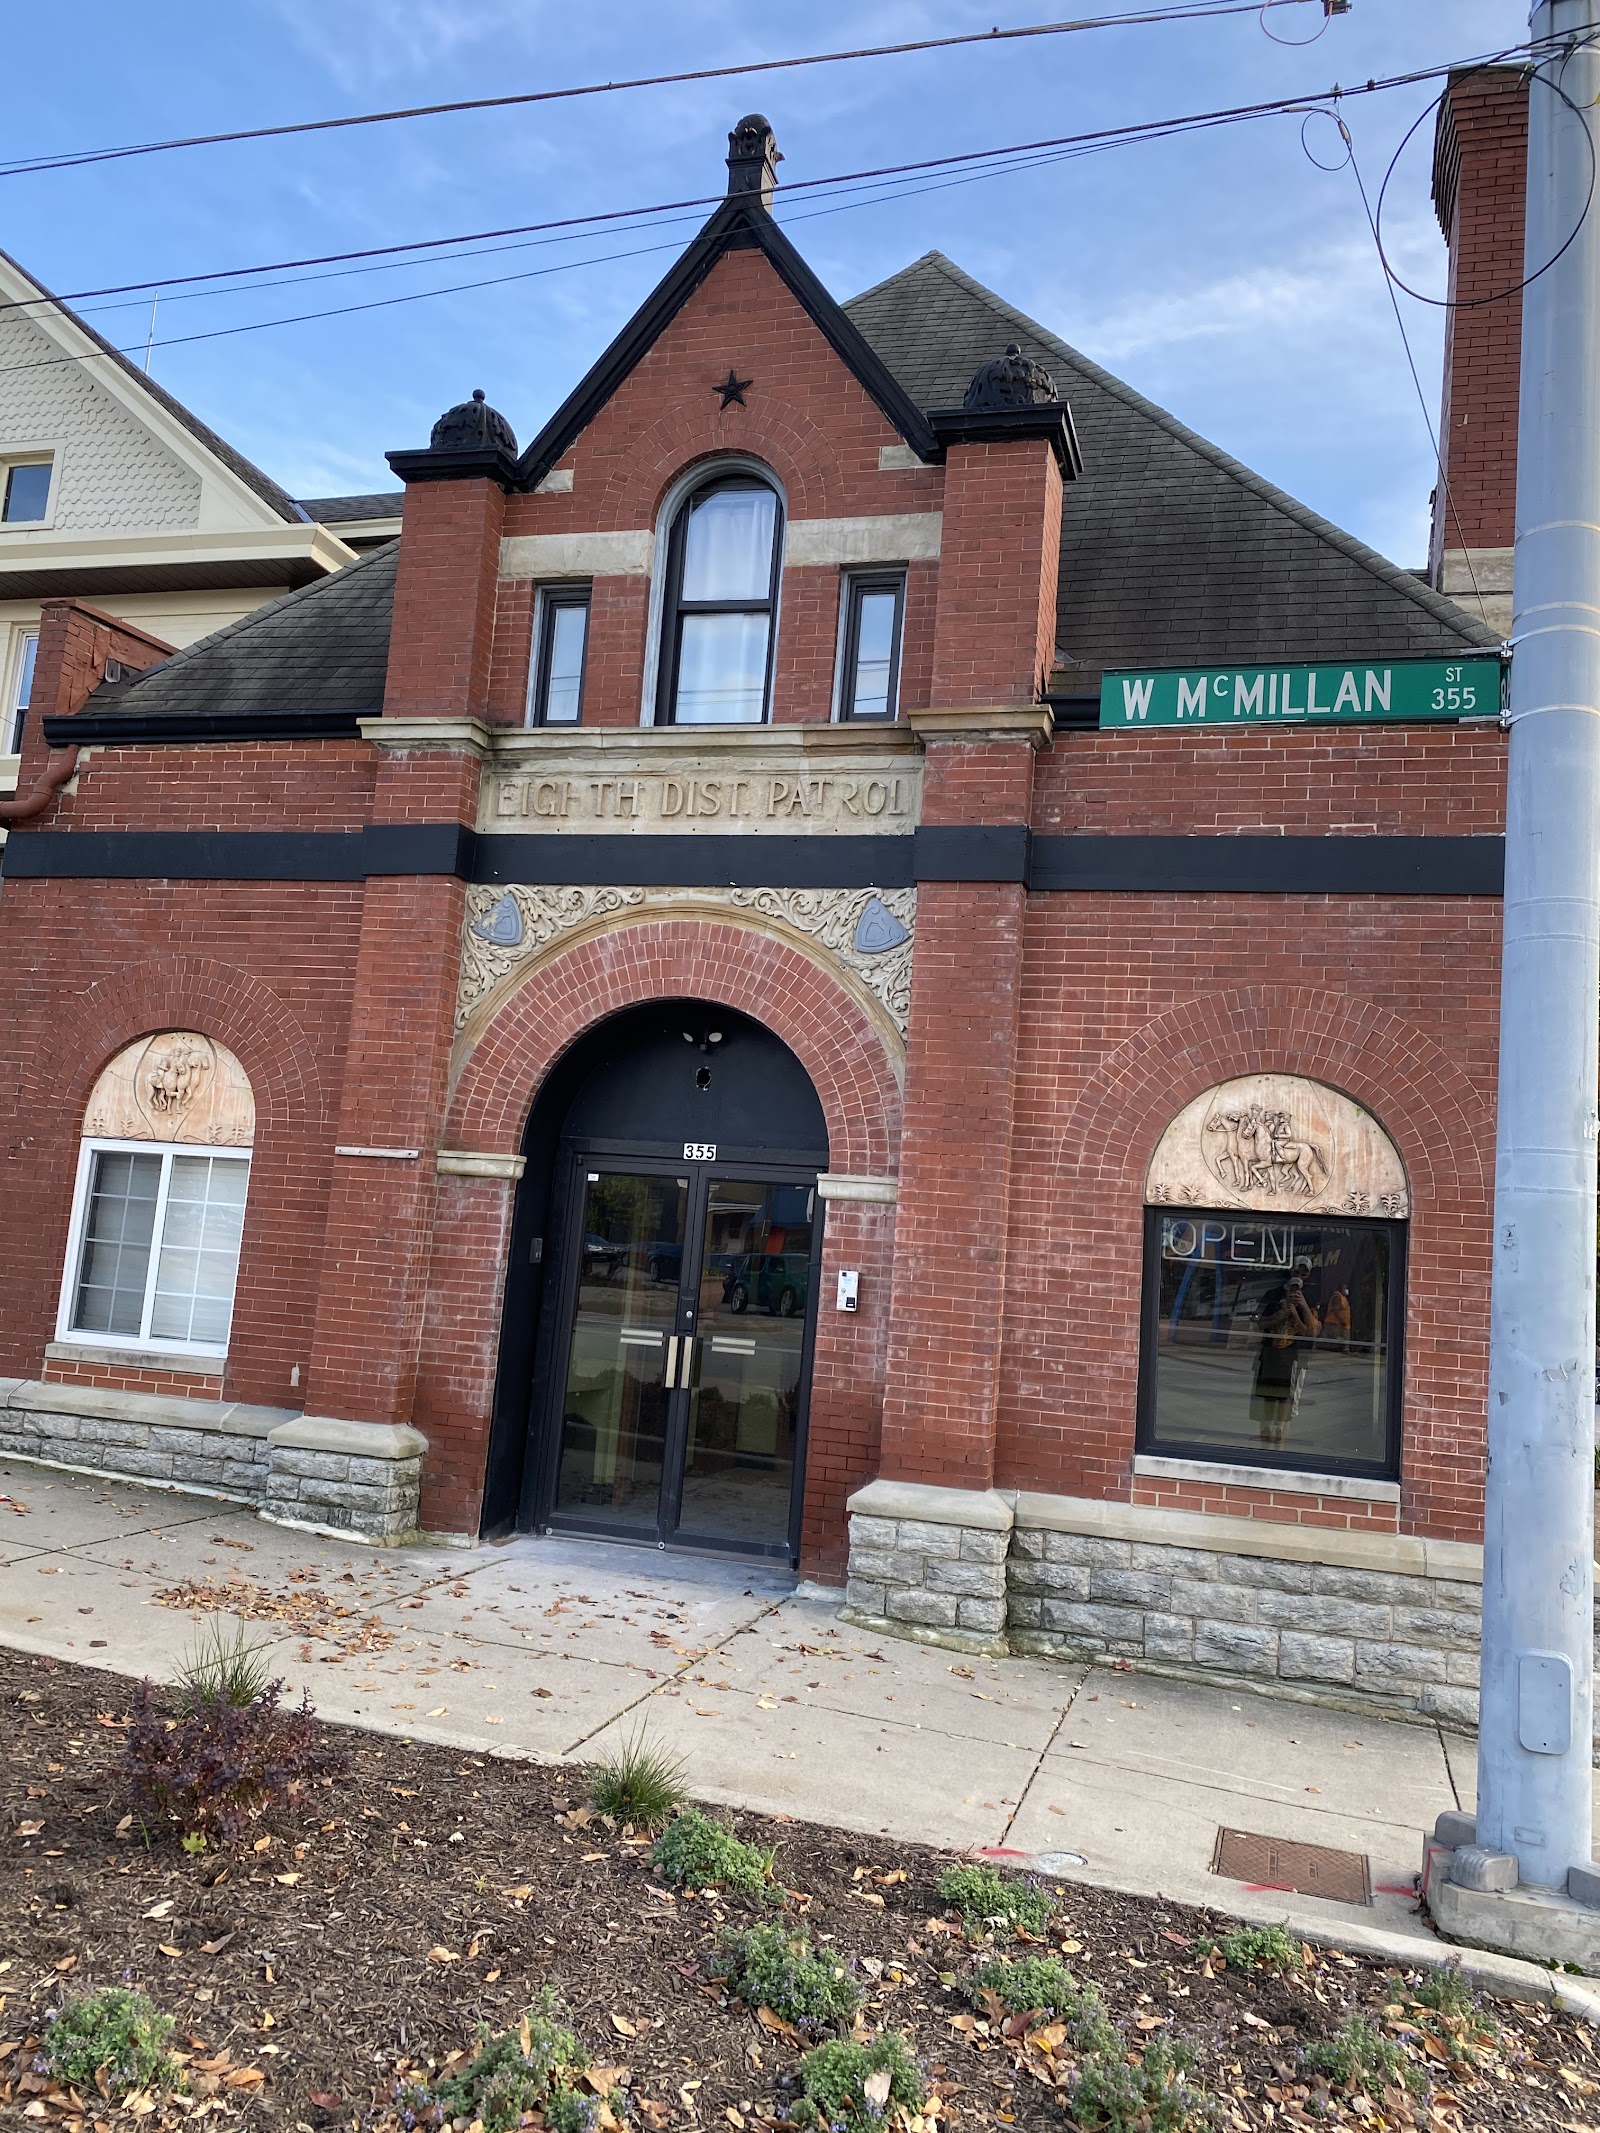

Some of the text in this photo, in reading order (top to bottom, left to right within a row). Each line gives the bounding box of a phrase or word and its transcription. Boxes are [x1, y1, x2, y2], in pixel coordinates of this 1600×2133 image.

[1445, 667, 1463, 682] ST
[1122, 678, 1155, 720] W
[1431, 687, 1476, 710] 355
[685, 1144, 715, 1160] 355
[1170, 1220, 1288, 1264] OPEN
